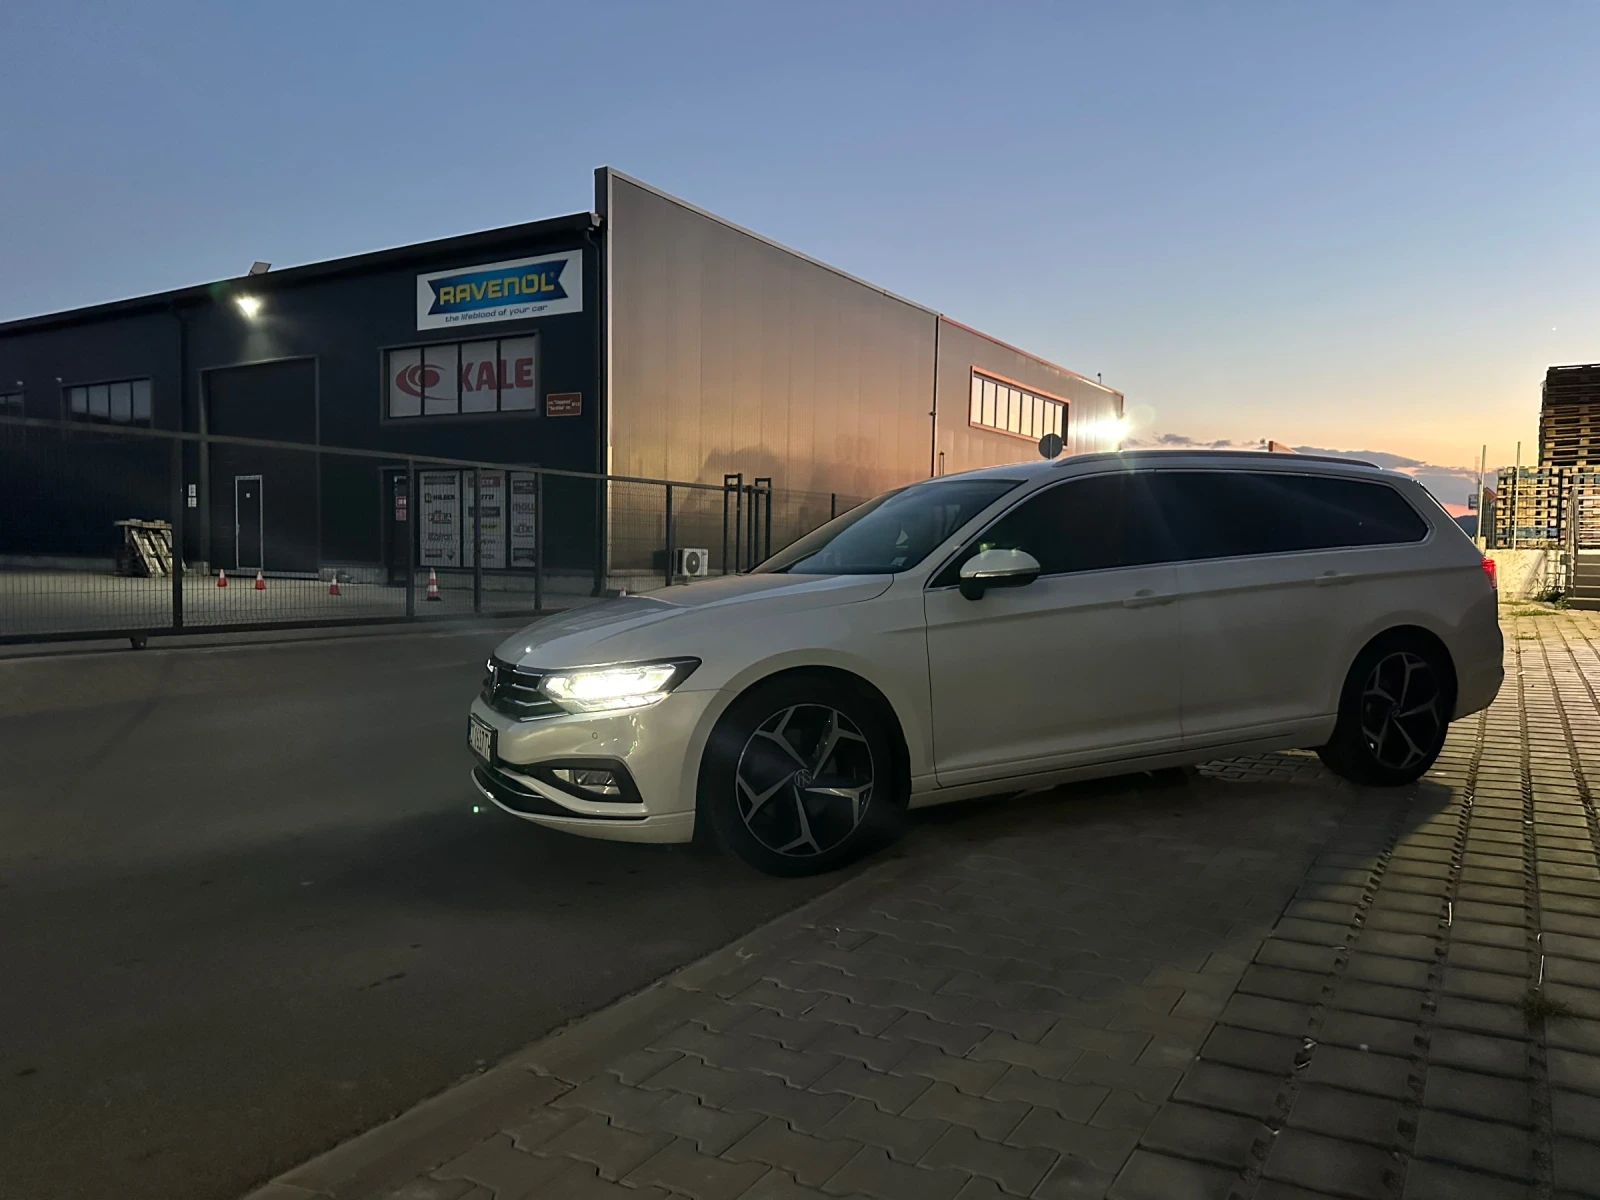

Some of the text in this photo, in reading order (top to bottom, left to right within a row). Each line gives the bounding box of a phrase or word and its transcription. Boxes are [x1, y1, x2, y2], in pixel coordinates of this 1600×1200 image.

[439, 273, 555, 306] RAVENOL
[445, 314, 459, 323] the
[460, 309, 496, 321] lifeblood
[509, 307, 530, 316] your
[531, 304, 548, 312] car
[459, 357, 534, 393] KALE
